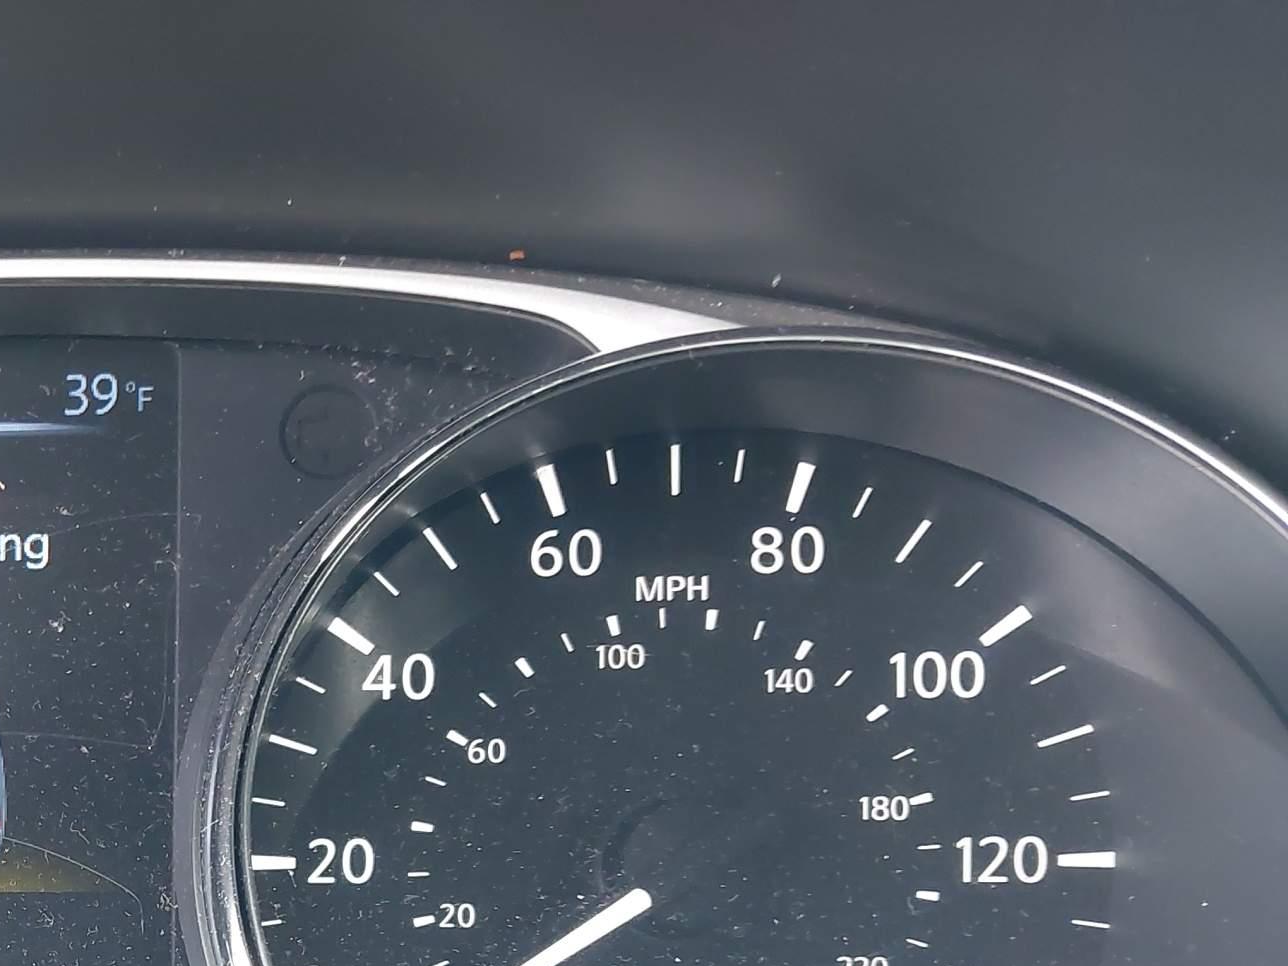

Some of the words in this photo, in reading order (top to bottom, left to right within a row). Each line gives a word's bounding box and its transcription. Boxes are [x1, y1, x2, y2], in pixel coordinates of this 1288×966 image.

[531, 529, 601, 576] 60
[751, 526, 824, 574] 80
[636, 576, 708, 601] MPH
[596, 644, 646, 669] 100
[362, 654, 434, 700] 40
[765, 668, 813, 693] 140
[890, 651, 984, 698] 100
[468, 739, 505, 763] 60
[859, 796, 909, 820] 180
[308, 838, 374, 884] 20
[956, 836, 1047, 883] 120
[439, 904, 475, 928] 20
